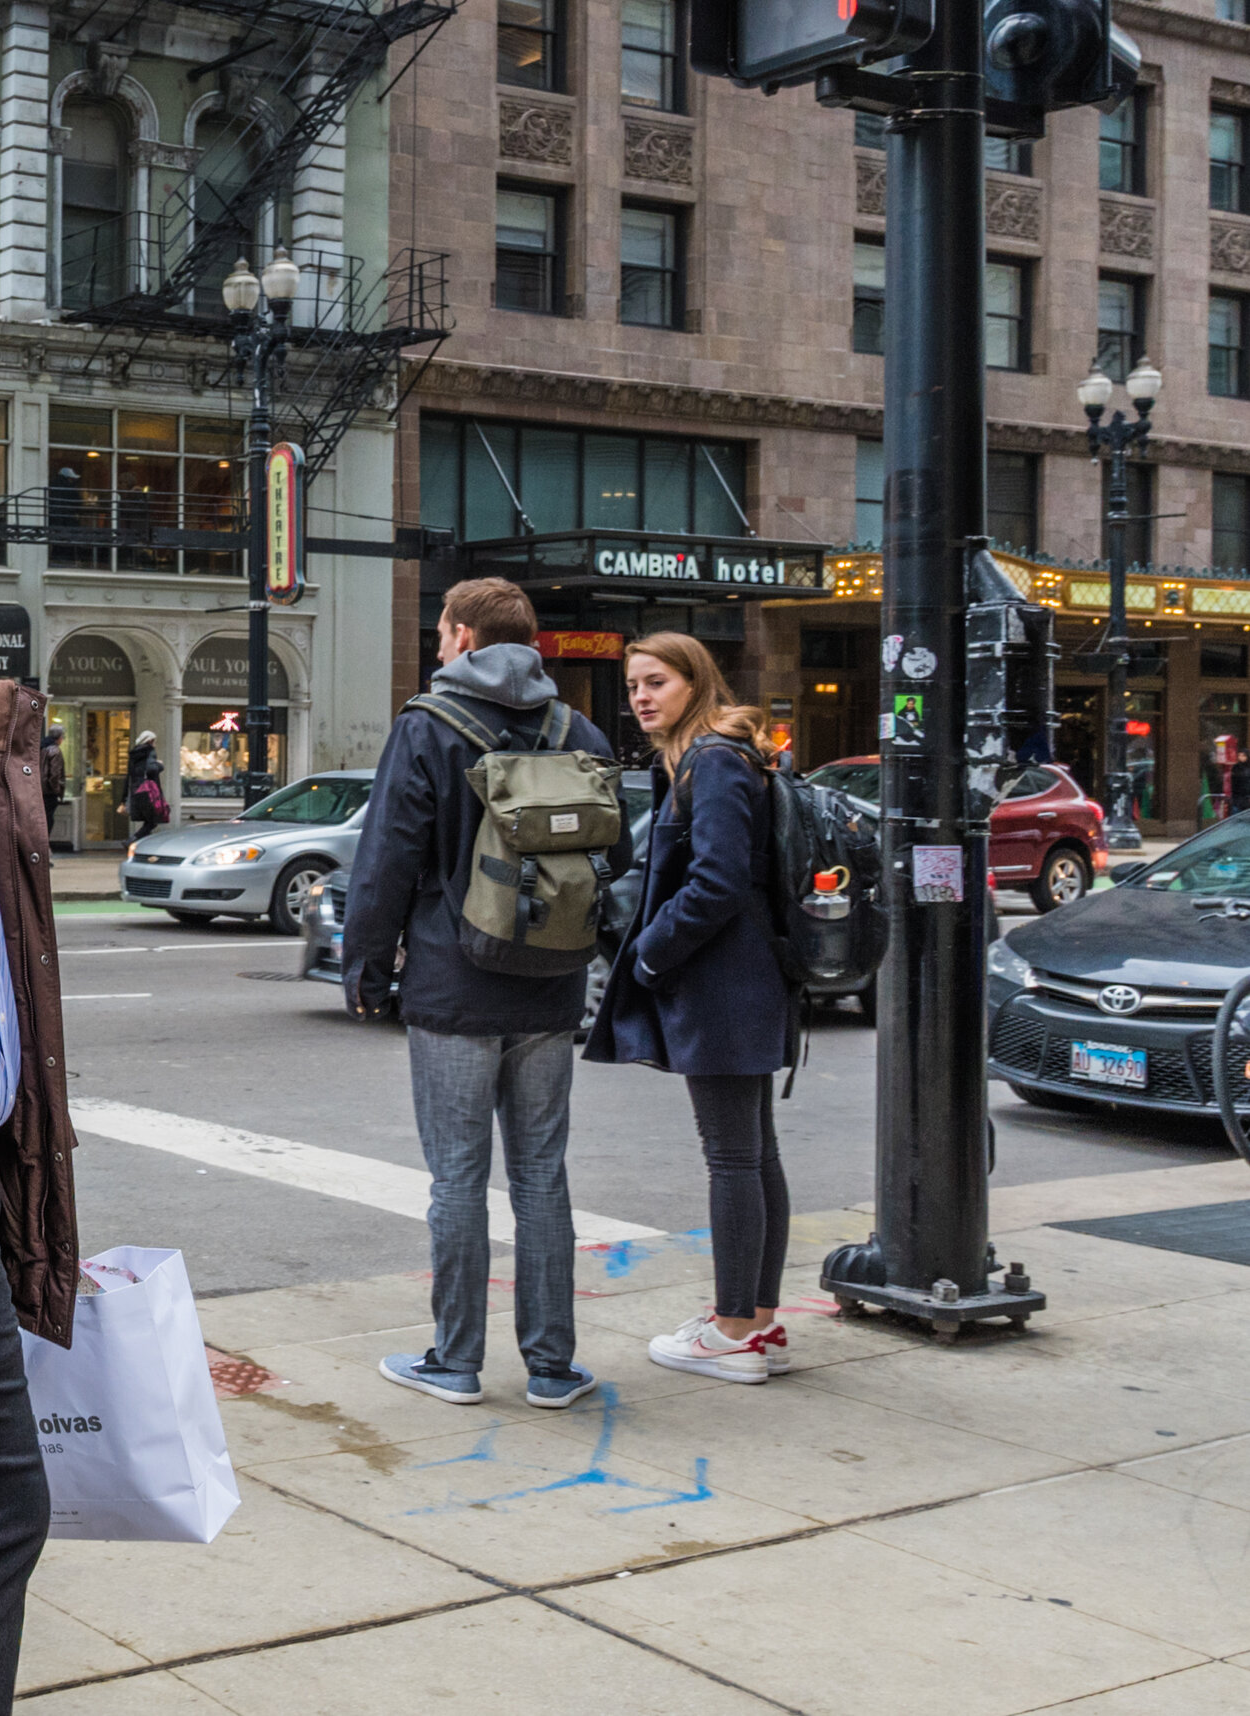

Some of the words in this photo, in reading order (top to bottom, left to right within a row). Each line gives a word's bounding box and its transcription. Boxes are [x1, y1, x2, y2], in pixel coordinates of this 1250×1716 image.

[716, 557, 785, 584] hotel
[68, 656, 123, 671] YOUNG
[222, 677, 249, 687] JEWEL
[31, 1413, 103, 1435] oivas
